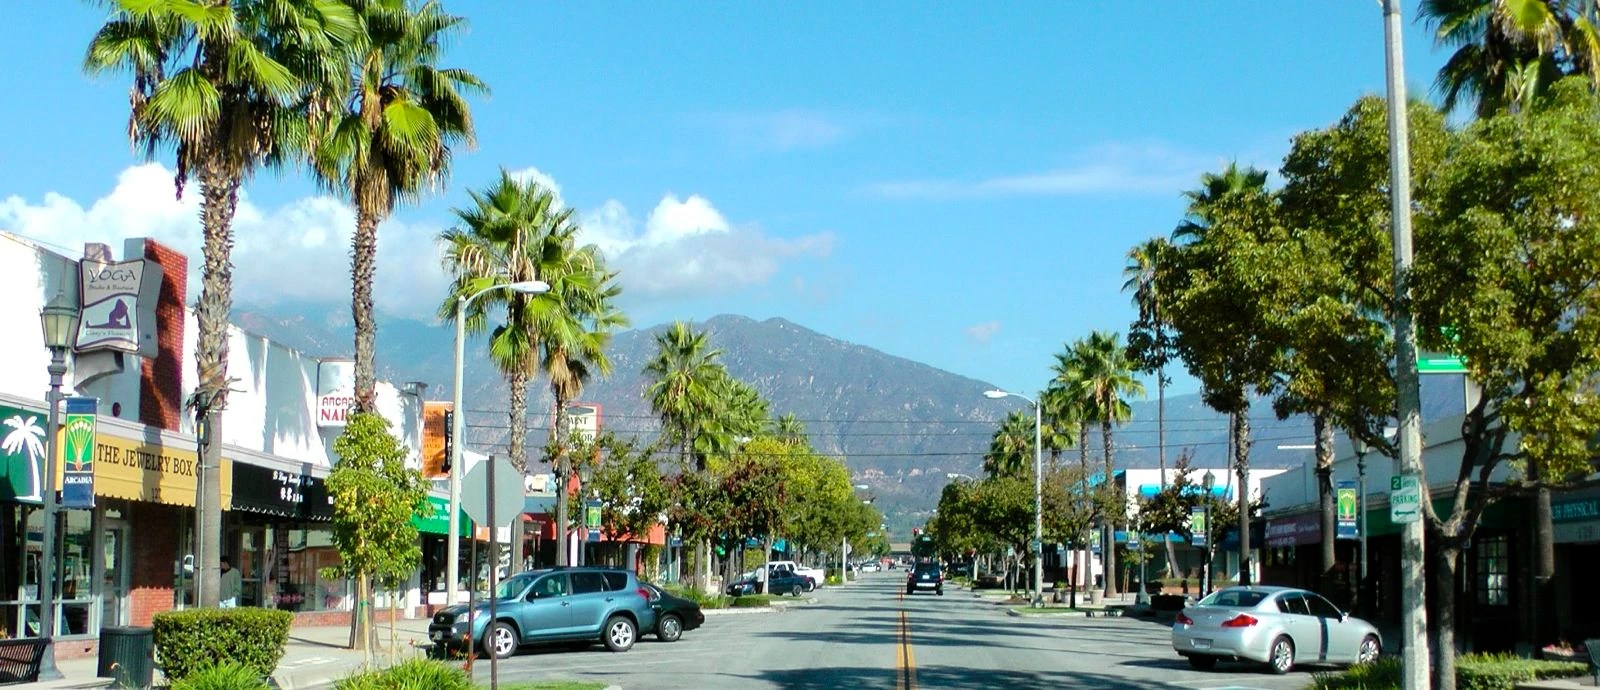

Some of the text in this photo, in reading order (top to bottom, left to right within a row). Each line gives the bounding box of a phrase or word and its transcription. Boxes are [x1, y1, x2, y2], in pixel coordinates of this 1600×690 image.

[89, 268, 136, 283] YOGA
[97, 443, 119, 464] THE
[122, 449, 171, 473] JEWELRY
[173, 459, 193, 477] BOX
[64, 476, 92, 484] ARCADIA
[1392, 478, 1400, 489] 2
[1392, 495, 1418, 505] PARKING
